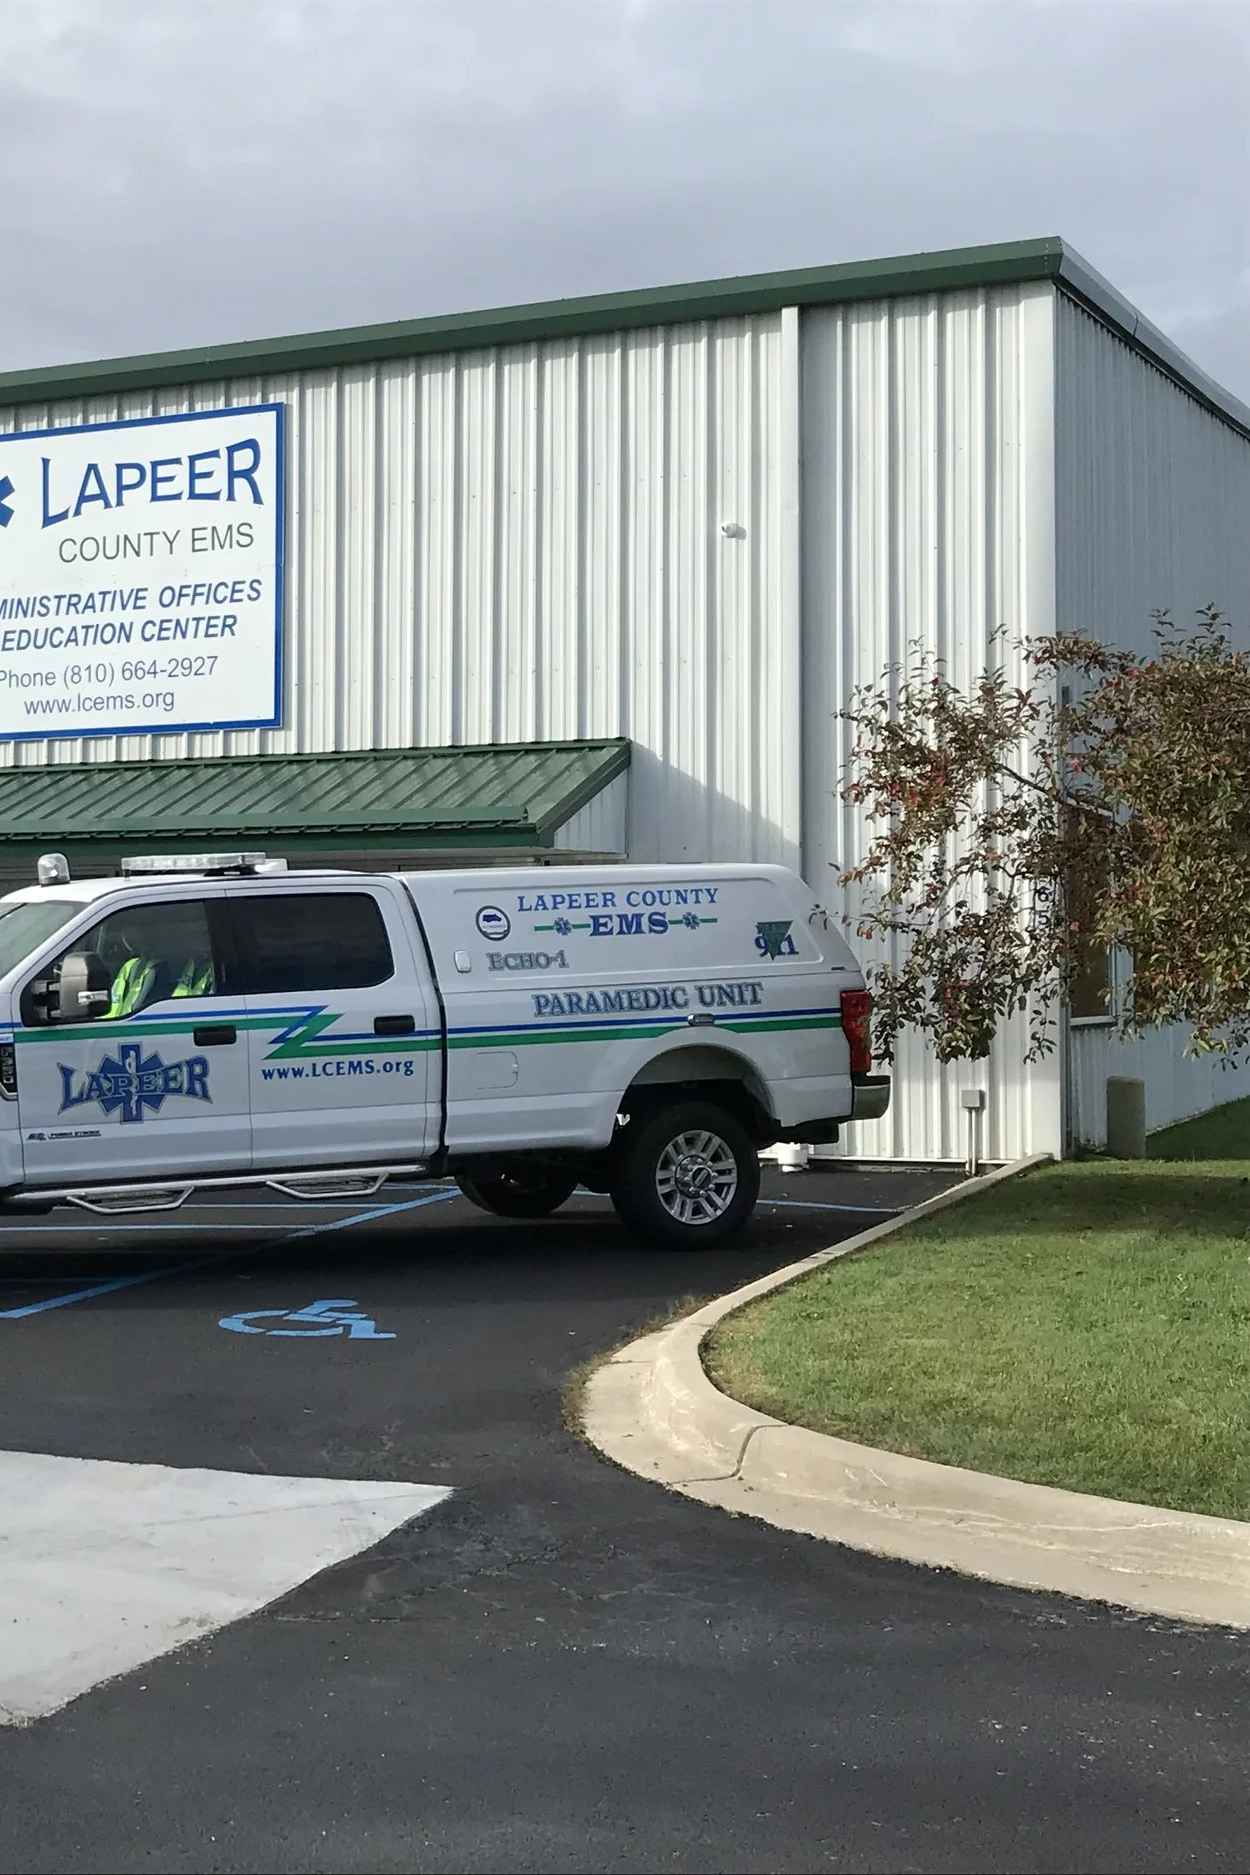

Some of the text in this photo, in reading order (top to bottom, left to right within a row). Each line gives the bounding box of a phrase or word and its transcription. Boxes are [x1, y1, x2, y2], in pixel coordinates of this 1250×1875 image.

[41, 438, 265, 529] LAPEER
[58, 522, 255, 563] COUNTY EMS
[158, 579, 263, 608] OFFICES
[1, 621, 134, 652] EDUCATION
[140, 614, 238, 643] CENTER
[63, 661, 116, 690] (810)
[121, 655, 219, 681] 664-2927
[24, 691, 175, 715] www.lcems.org
[517, 887, 719, 912] LAPEER COUNTY
[589, 911, 669, 937] EMS
[754, 934, 799, 957] 911
[486, 949, 570, 972] ECHO-1
[531, 980, 765, 1018] PARAMEDIC UNIT
[261, 1059, 415, 1081] www.LCEMS.org
[56, 1055, 214, 1116] LAPEER
